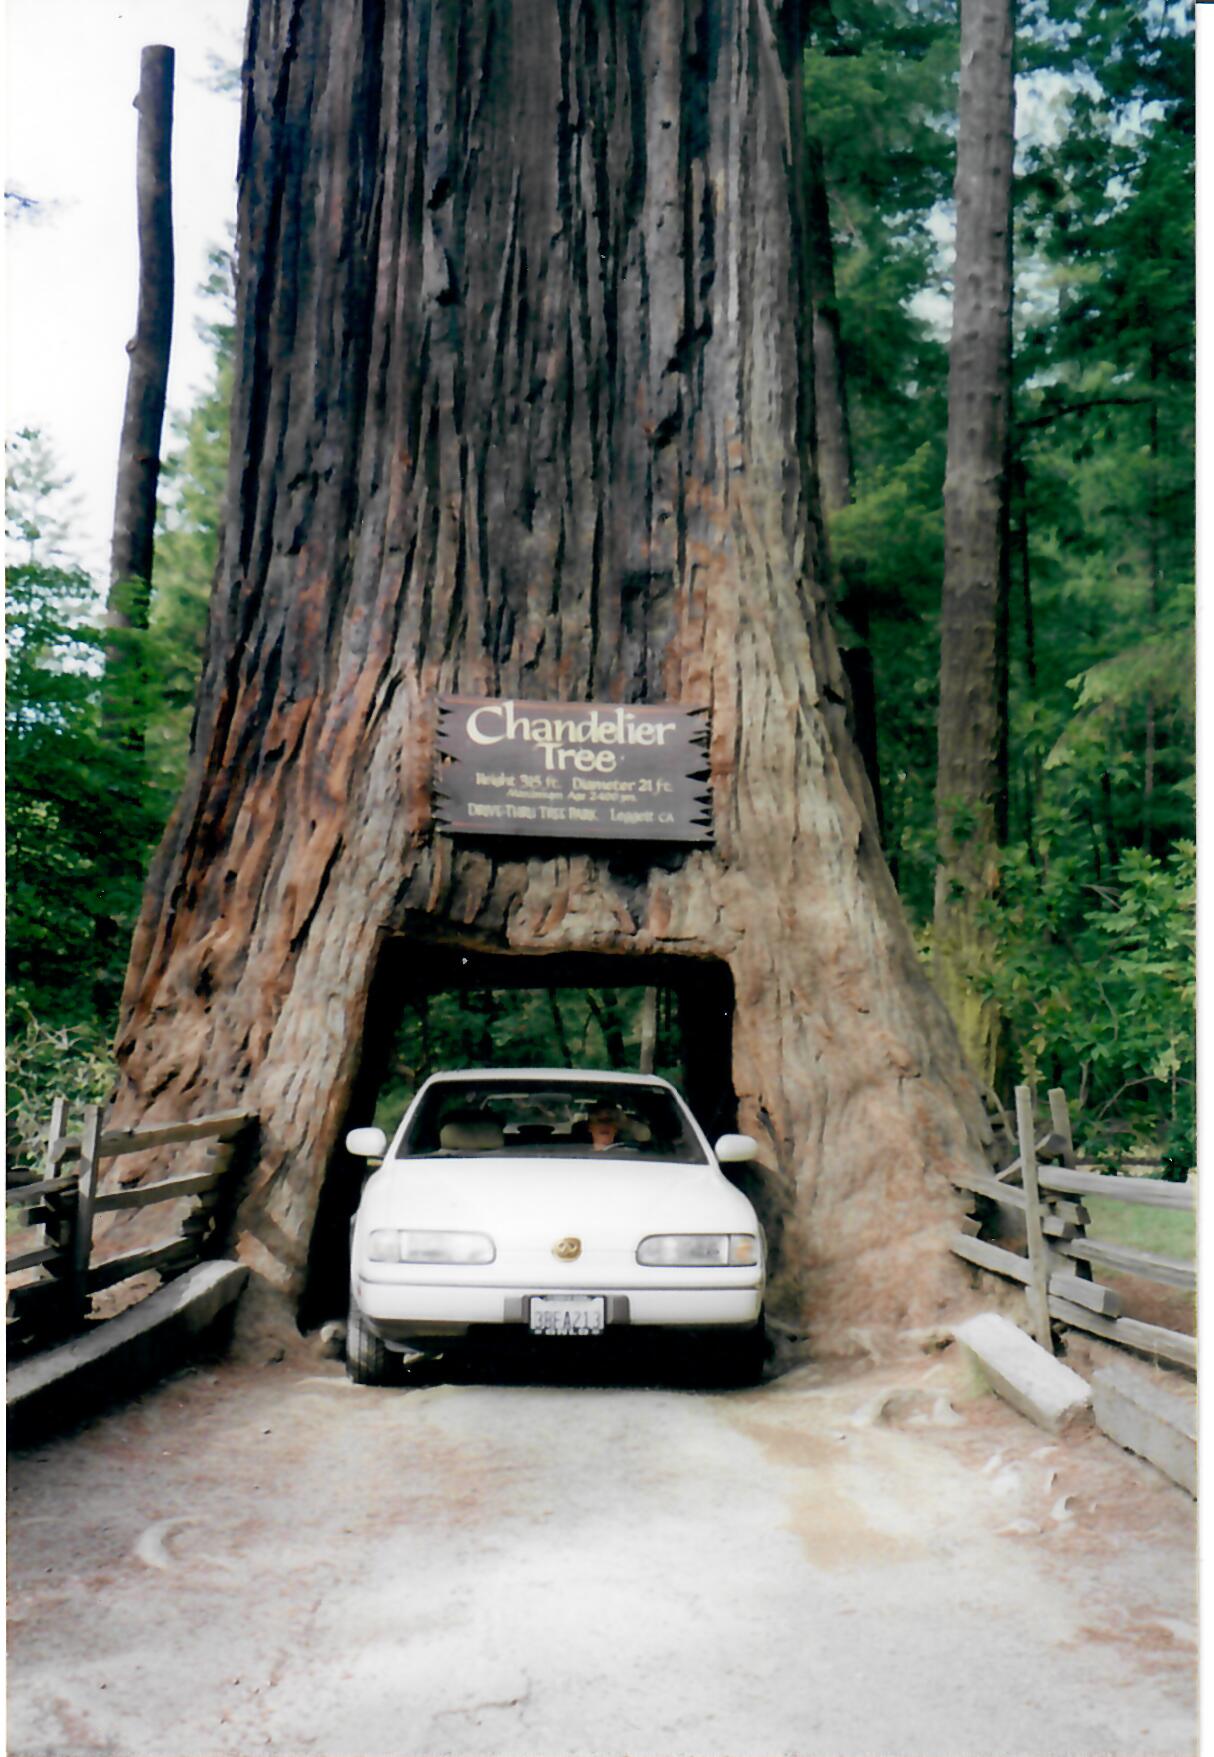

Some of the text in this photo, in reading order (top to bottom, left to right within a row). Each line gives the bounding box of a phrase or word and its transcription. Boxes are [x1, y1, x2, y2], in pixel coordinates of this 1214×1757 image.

[466, 700, 676, 745] Chandelier
[537, 742, 617, 773] Tree
[571, 776, 636, 792] Diameter
[638, 778, 653, 792] 21
